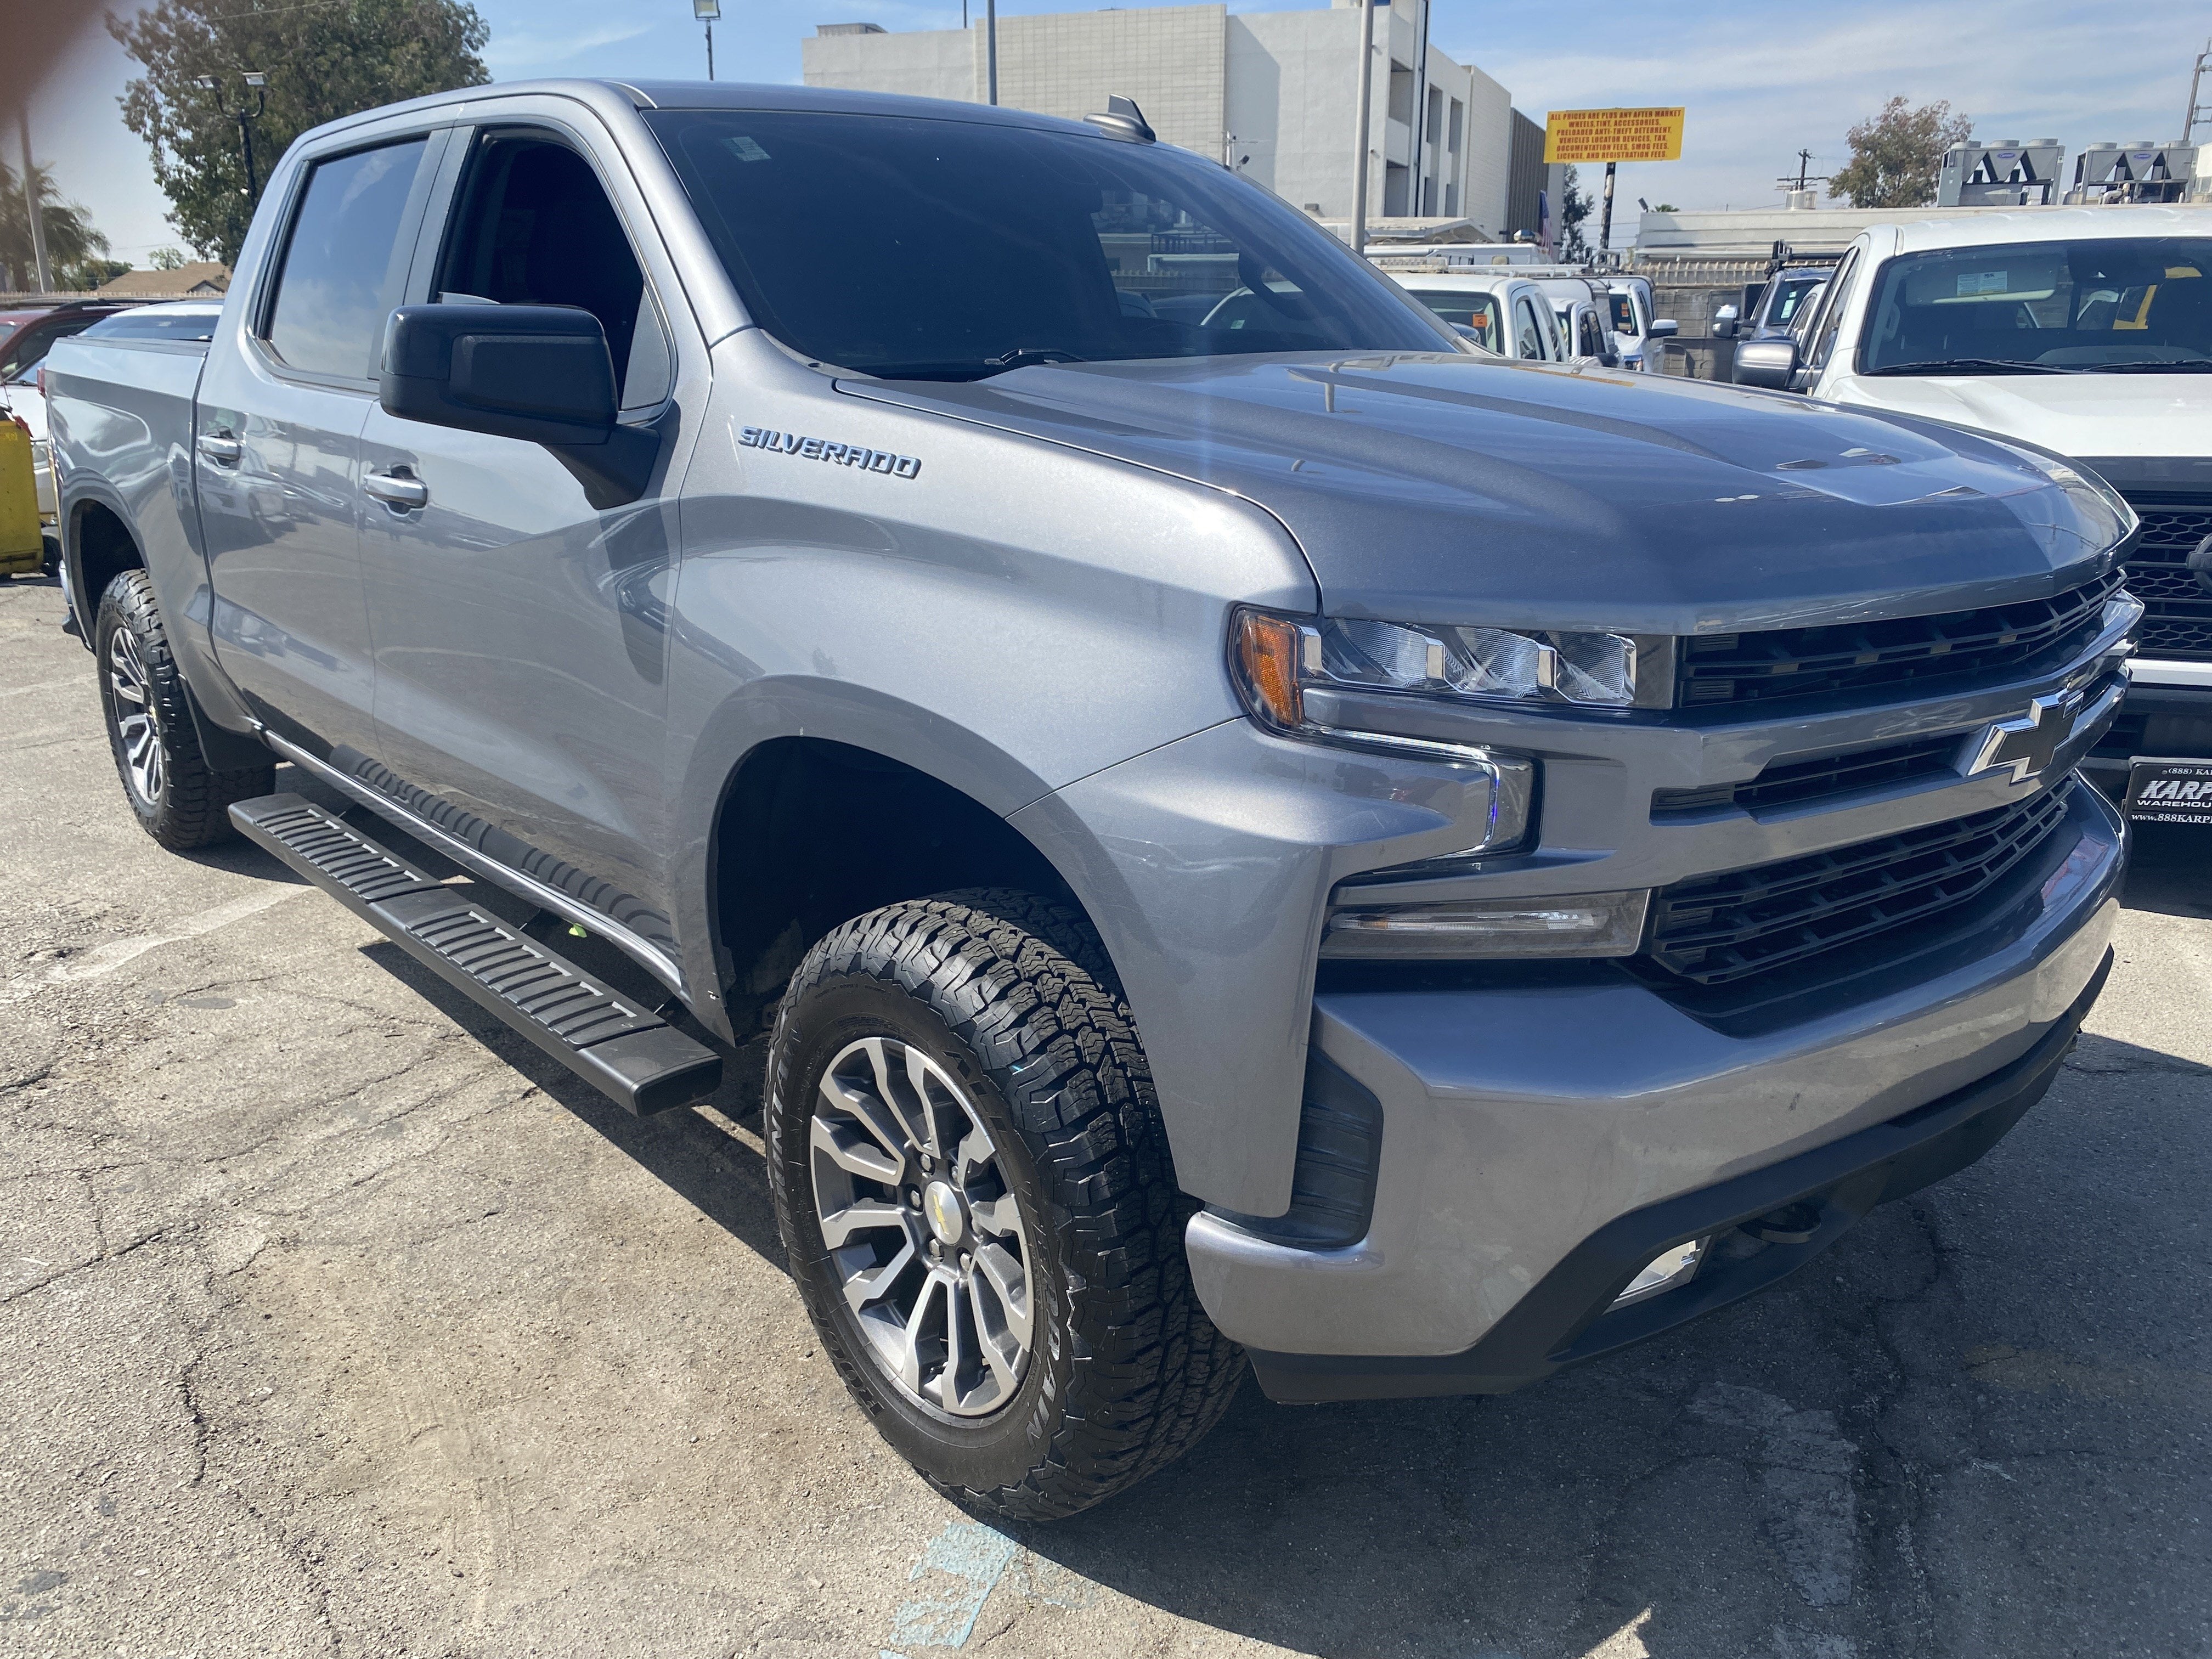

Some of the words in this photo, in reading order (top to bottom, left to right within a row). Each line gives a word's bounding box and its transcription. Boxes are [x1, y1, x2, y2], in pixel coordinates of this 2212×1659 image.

[737, 426, 923, 480] SILVERADO
[2138, 780, 2212, 800] KARP
[2137, 799, 2212, 808] WAREHOU
